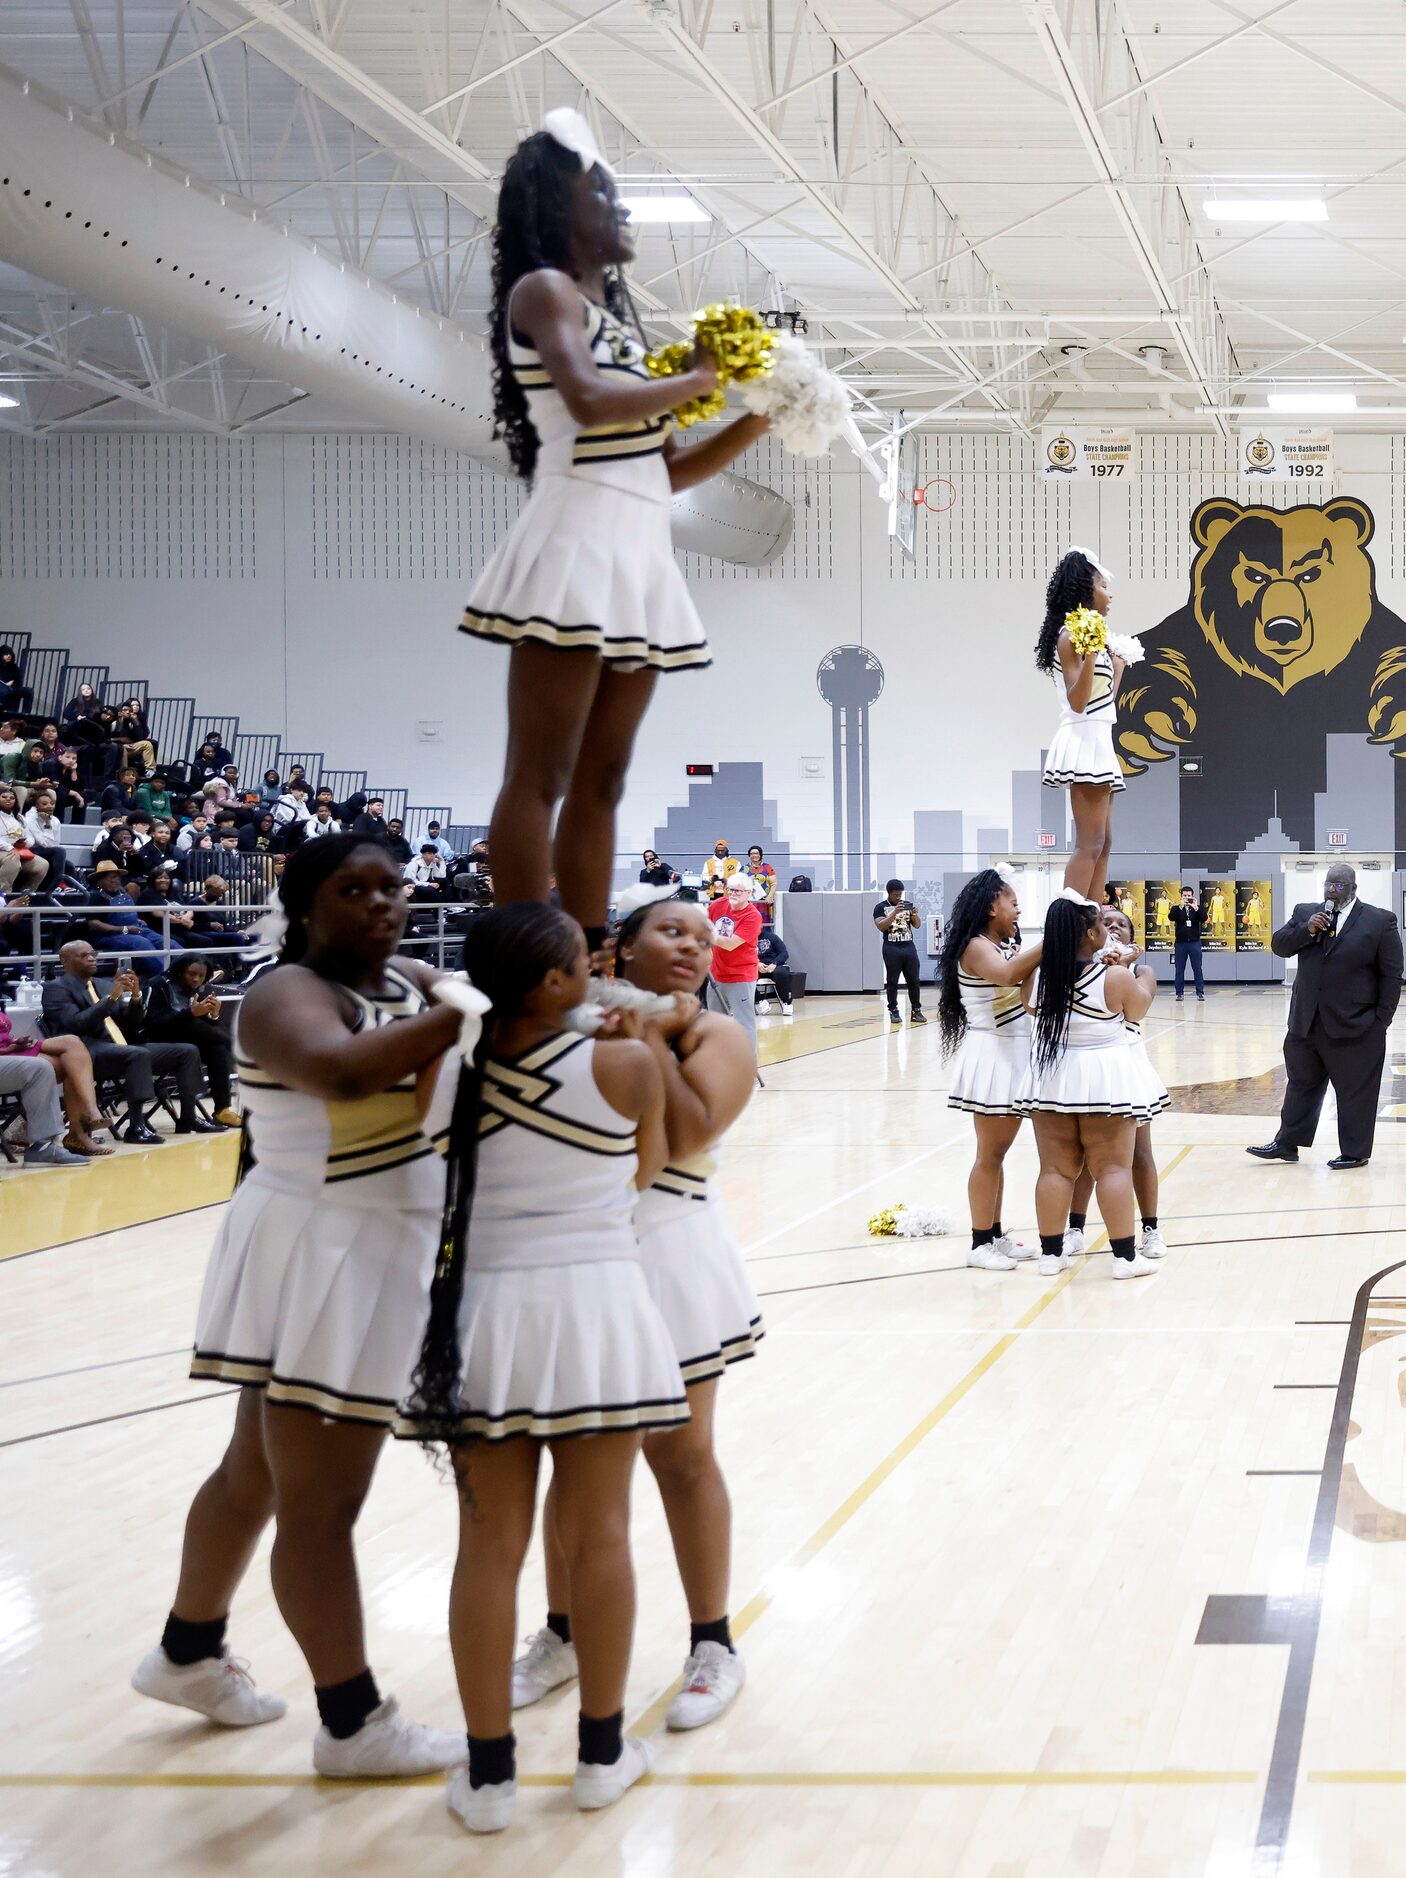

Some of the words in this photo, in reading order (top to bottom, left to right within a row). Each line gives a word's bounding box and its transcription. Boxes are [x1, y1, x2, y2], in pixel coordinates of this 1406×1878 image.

[1084, 445, 1098, 453] Boys
[1100, 444, 1131, 452] Basketball
[1282, 445, 1296, 453] Boys
[1091, 465, 1124, 476] 1977
[1289, 465, 1324, 476] 1992
[1040, 834, 1055, 845] EXIT
[1331, 833, 1345, 844] EXIT
